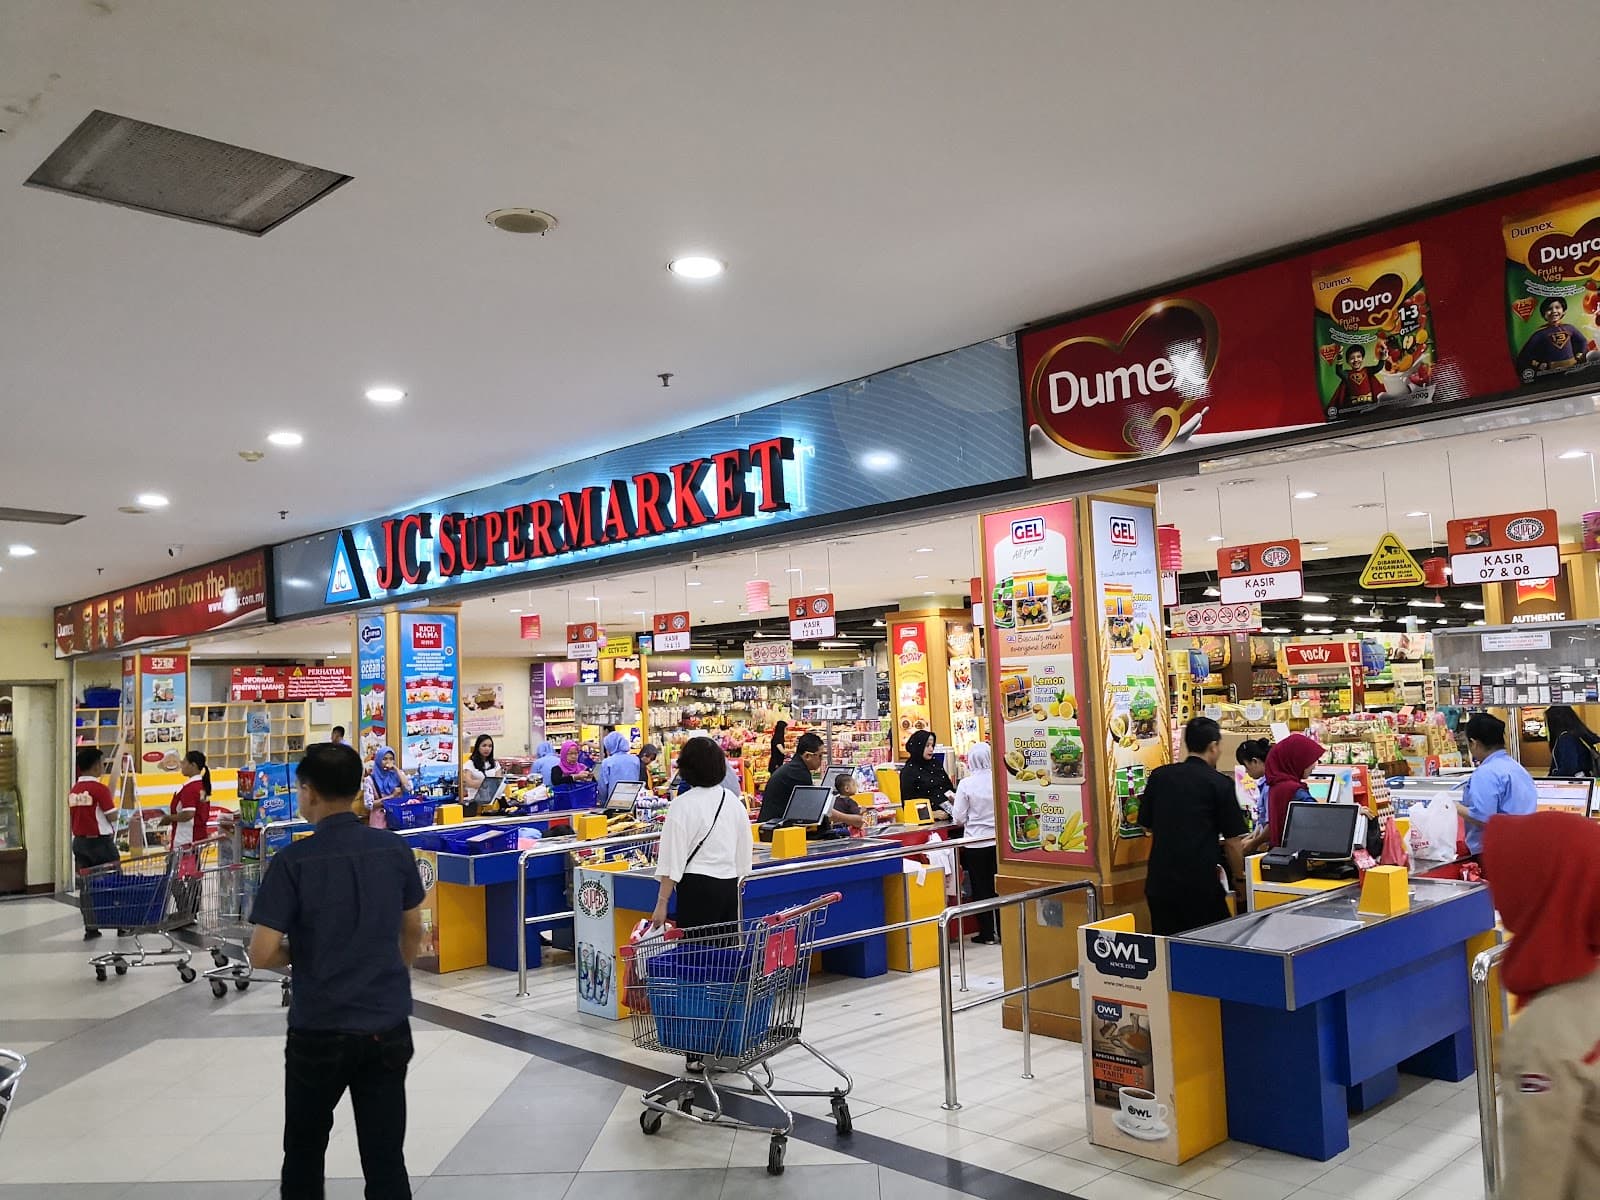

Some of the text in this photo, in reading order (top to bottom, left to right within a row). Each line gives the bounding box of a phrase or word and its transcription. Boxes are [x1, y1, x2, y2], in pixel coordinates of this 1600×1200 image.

[1511, 221, 1553, 239] Dumex
[1319, 276, 1353, 290] Dumex
[1543, 274, 1561, 283] Veg
[1342, 291, 1392, 314] Dugro
[1398, 304, 1419, 320] 1-3
[376, 437, 788, 590] JC SUPERMARKET
[1014, 523, 1041, 540] GEL
[1112, 522, 1134, 540] GEL
[1513, 524, 1537, 536] SUPER
[1267, 551, 1286, 563] SUPER
[1484, 553, 1524, 566] KASIR
[1372, 571, 1395, 580] CCTV
[1480, 566, 1530, 579] 07 & 08
[335, 569, 347, 590] JC
[1245, 577, 1275, 588] KASIR
[136, 560, 264, 615] Nutrition from the heart
[1254, 589, 1267, 598] 09
[1512, 611, 1565, 623] AUTHENTIC
[803, 620, 821, 629] KASIR
[307, 668, 345, 676] PERHATIAN
[243, 676, 275, 684] INFORMASI
[1033, 674, 1065, 686] Lemon
[261, 683, 285, 691] BARANG
[1014, 737, 1047, 748] Durian
[1023, 748, 1047, 758] Cream
[1041, 803, 1065, 815] Corn
[1042, 815, 1066, 824] Cream
[583, 889, 604, 910] SUPER
[1093, 937, 1149, 964] OWL
[1097, 1004, 1119, 1017] OWL
[1127, 1104, 1152, 1118] OWL
